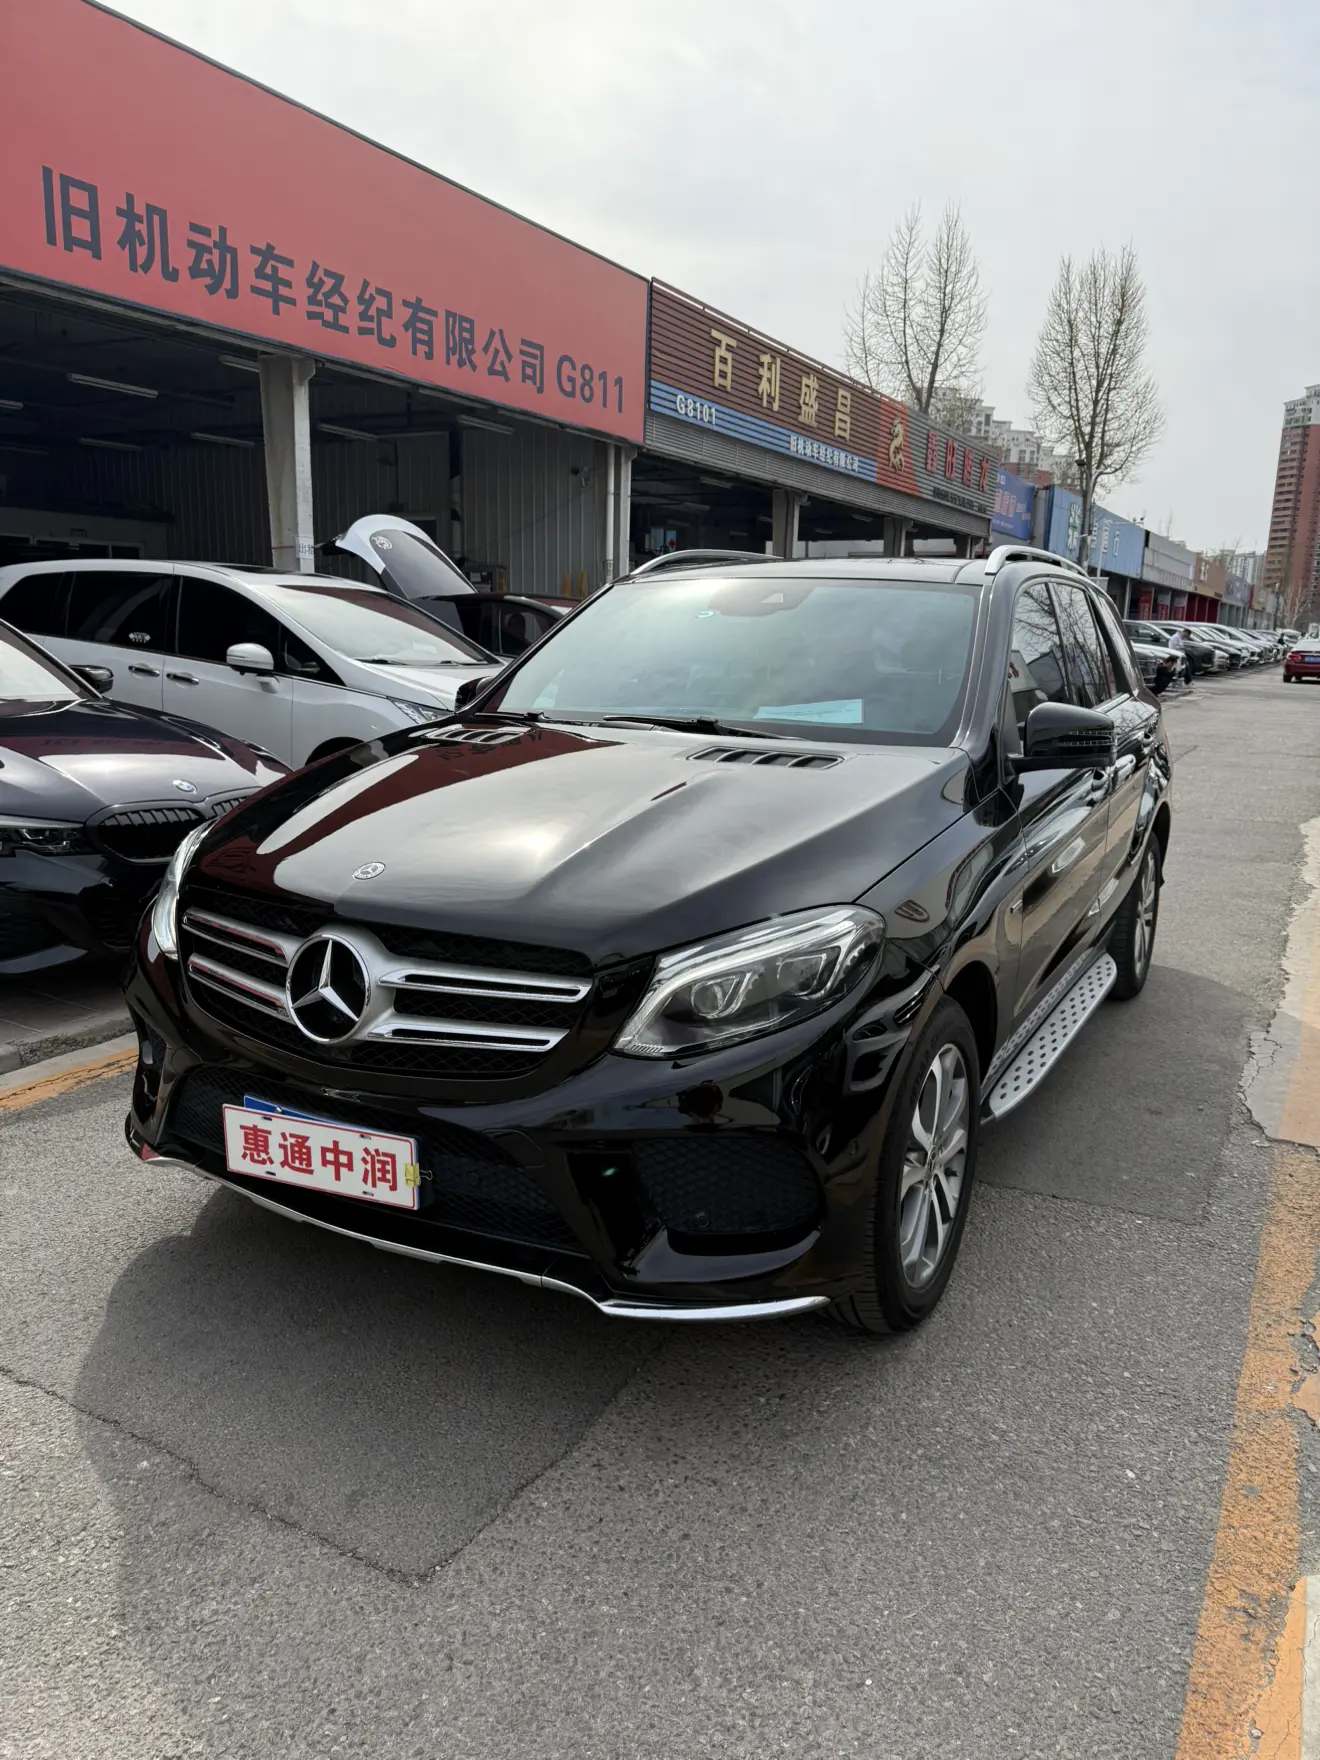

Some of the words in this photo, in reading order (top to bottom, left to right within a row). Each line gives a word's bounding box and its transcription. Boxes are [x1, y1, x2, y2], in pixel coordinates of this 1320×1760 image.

[42, 165, 545, 395] 旧机动车经纪有限公司
[556, 355, 624, 413] G811
[676, 394, 716, 426] G8101
[710, 328, 851, 441] 百利盛昌
[239, 1124, 398, 1191] 惠通中润
